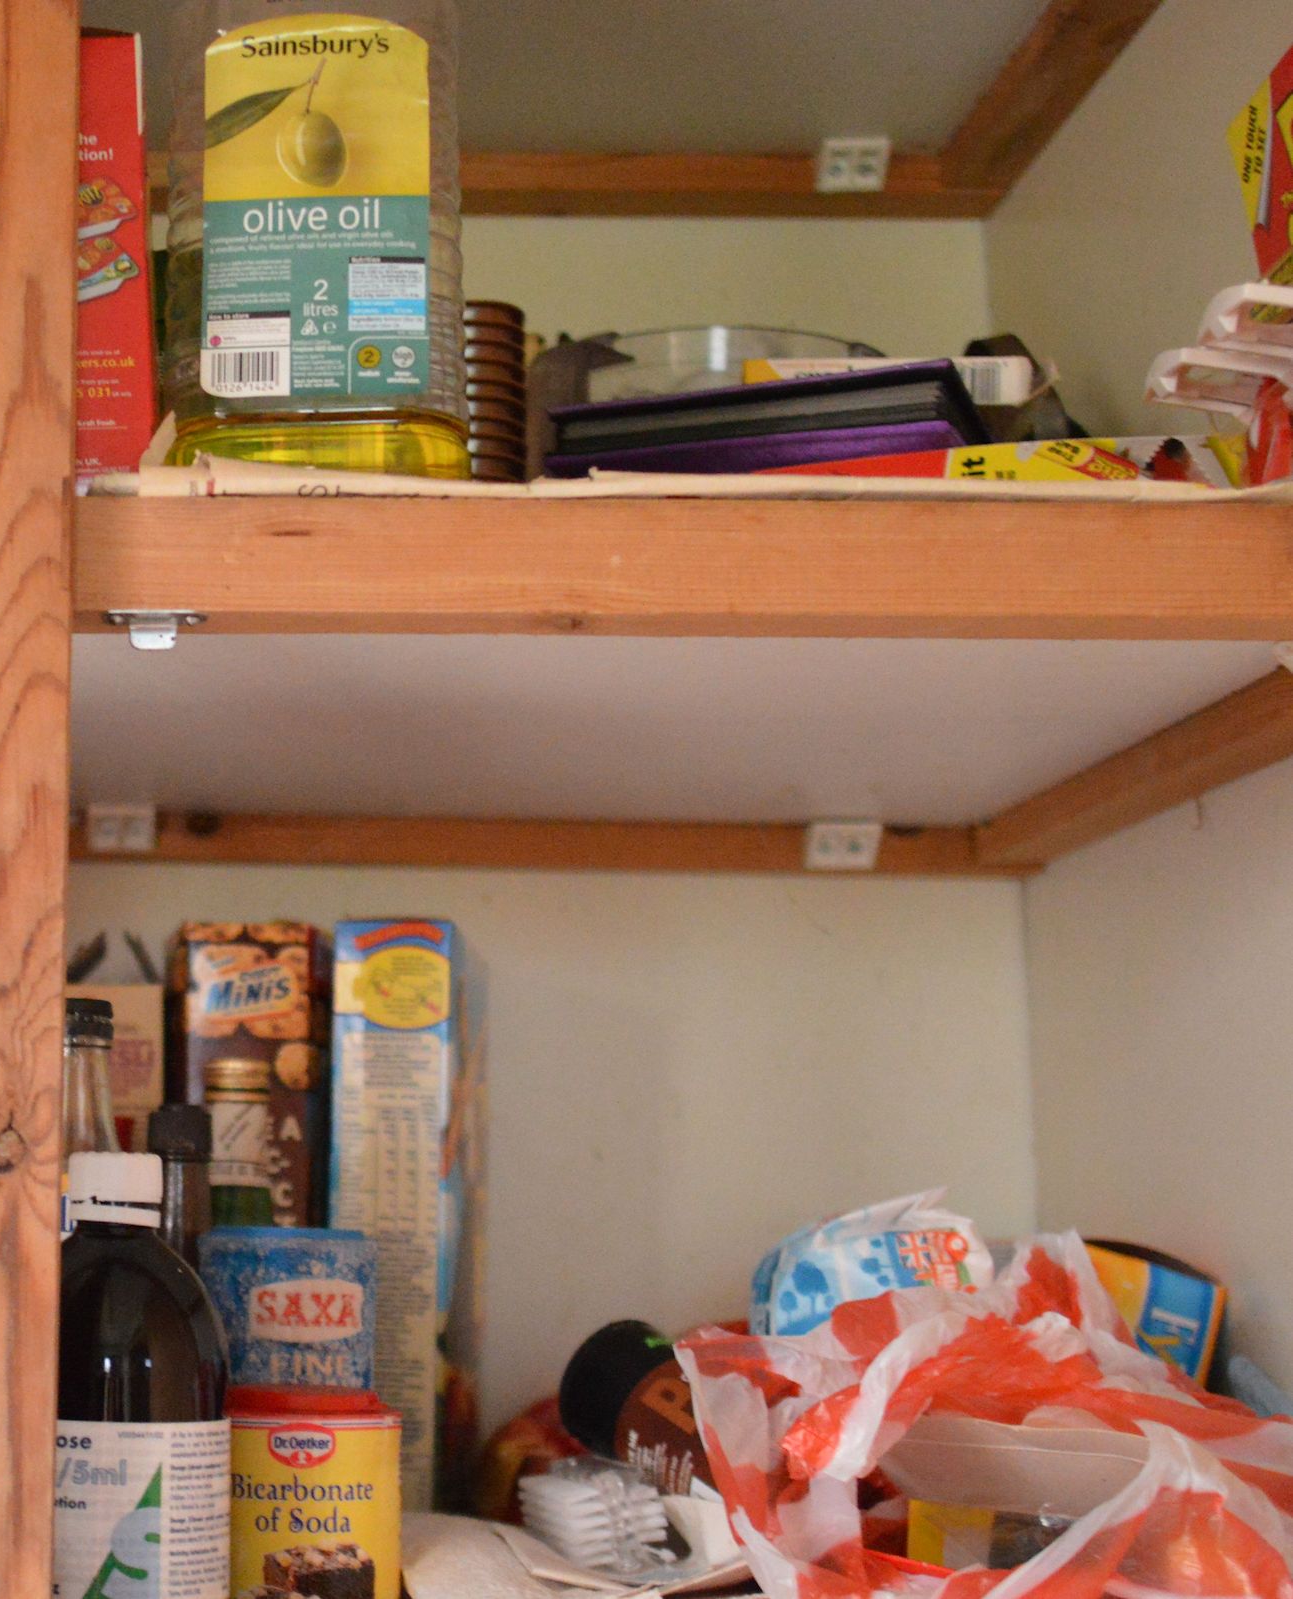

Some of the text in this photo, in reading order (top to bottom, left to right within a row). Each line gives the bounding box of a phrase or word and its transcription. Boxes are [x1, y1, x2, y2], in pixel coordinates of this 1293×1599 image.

[241, 33, 390, 60] Sainsbury's
[1243, 105, 1258, 184] ONE TOUCH
[1254, 128, 1266, 175] TO SET
[242, 198, 380, 234] olive oil
[313, 278, 329, 301] 2
[303, 302, 339, 318] litres
[256, 1290, 359, 1328] SAXA
[269, 1353, 352, 1378] FINE
[231, 1471, 374, 1502] Bicarbonate
[254, 1506, 352, 1535] of Soda
